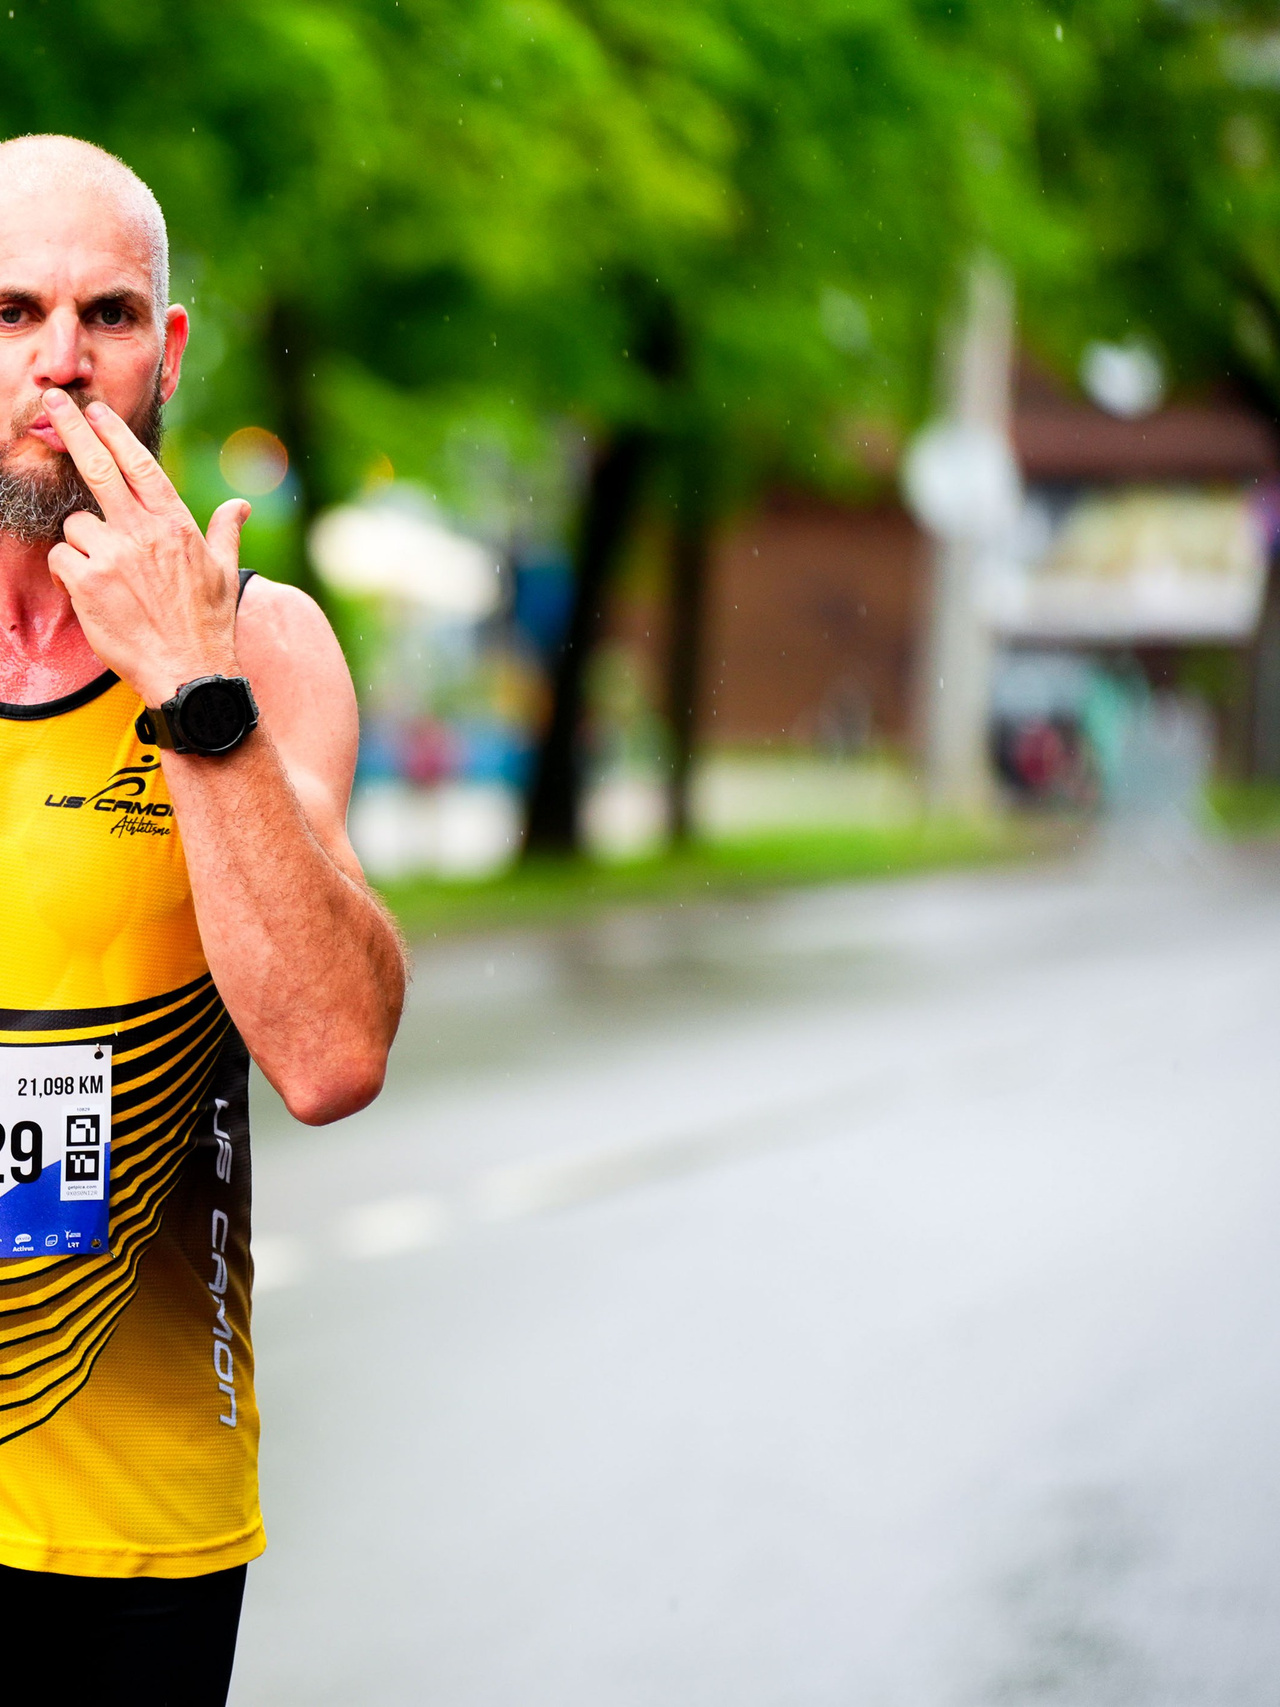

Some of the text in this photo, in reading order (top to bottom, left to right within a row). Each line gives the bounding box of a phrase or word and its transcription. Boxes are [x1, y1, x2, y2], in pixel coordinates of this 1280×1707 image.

[44, 794, 174, 817] US CAMO
[17, 1075, 104, 1099] 21,098 KM
[208, 1098, 237, 1428] US CAMON
